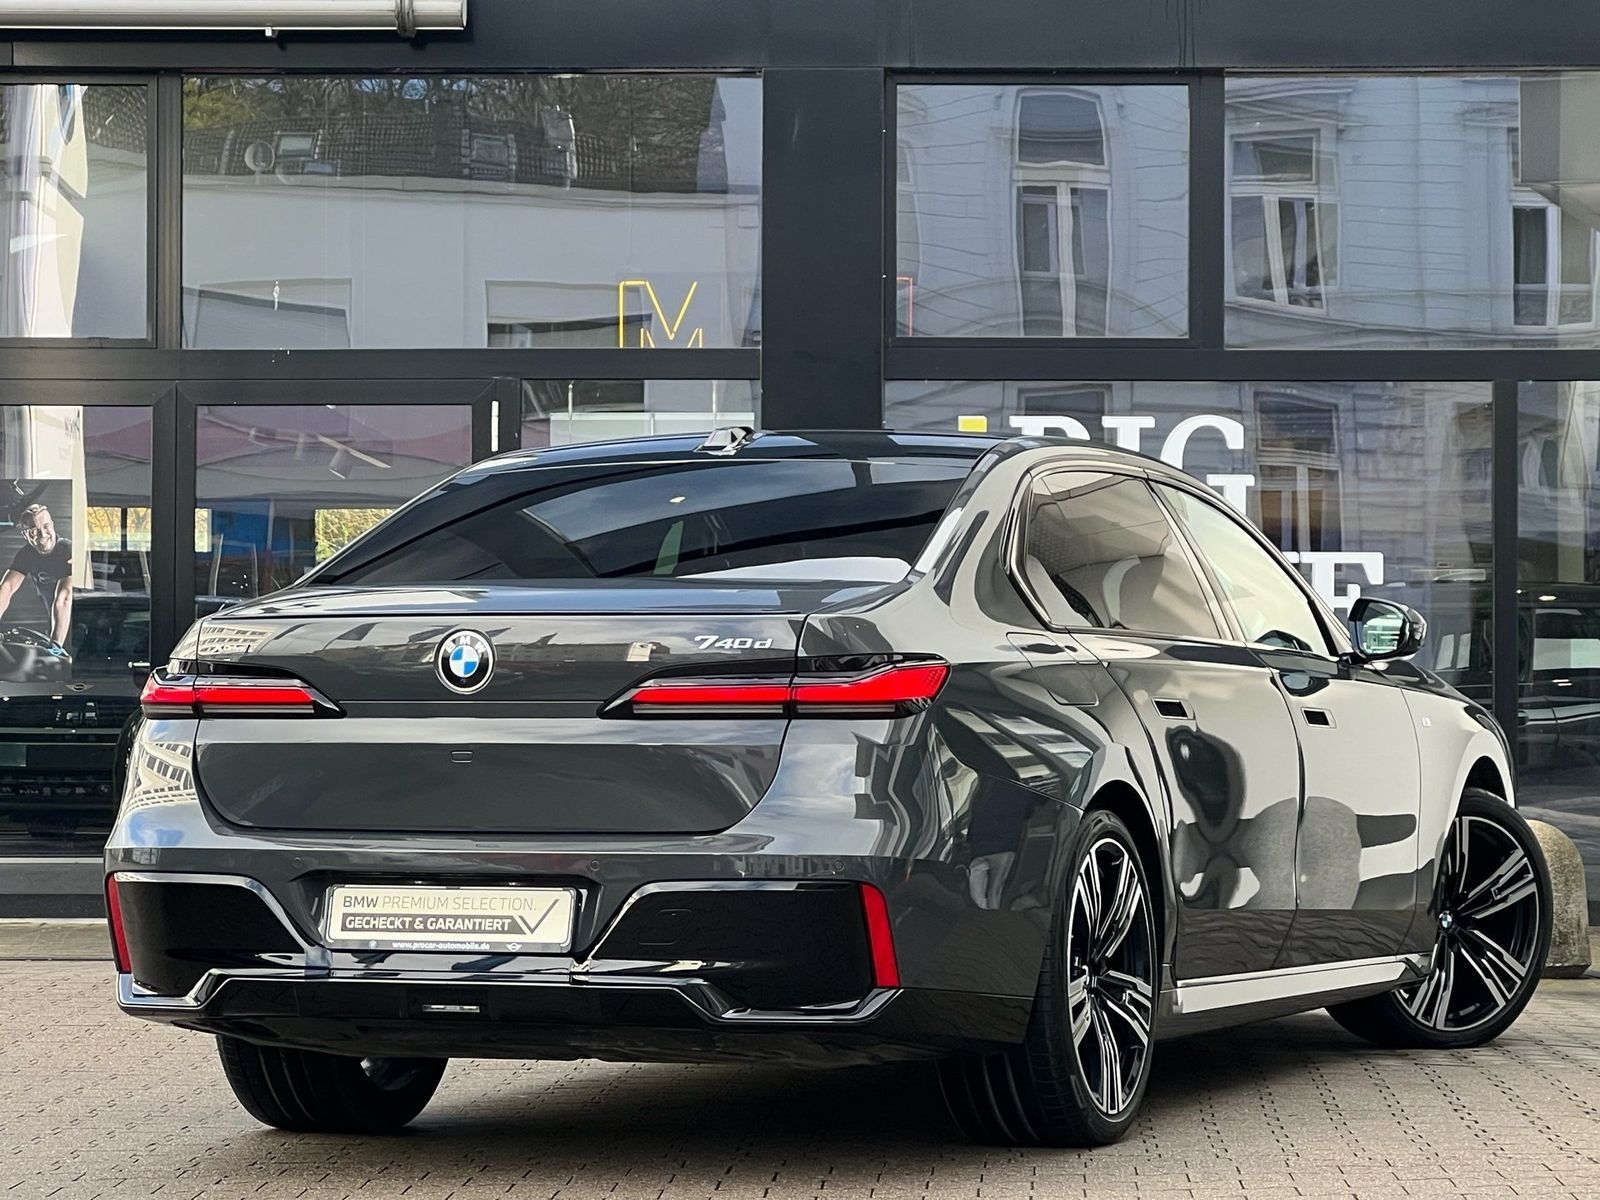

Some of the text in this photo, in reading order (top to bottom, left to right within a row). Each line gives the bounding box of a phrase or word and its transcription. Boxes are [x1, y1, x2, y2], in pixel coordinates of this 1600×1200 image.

[445, 635, 487, 657] BMW
[694, 635, 773, 650] 740d
[343, 895, 536, 912] BMW PREMIUM SELECTION.
[345, 915, 511, 932] GECHECKT & GARANTIERT
